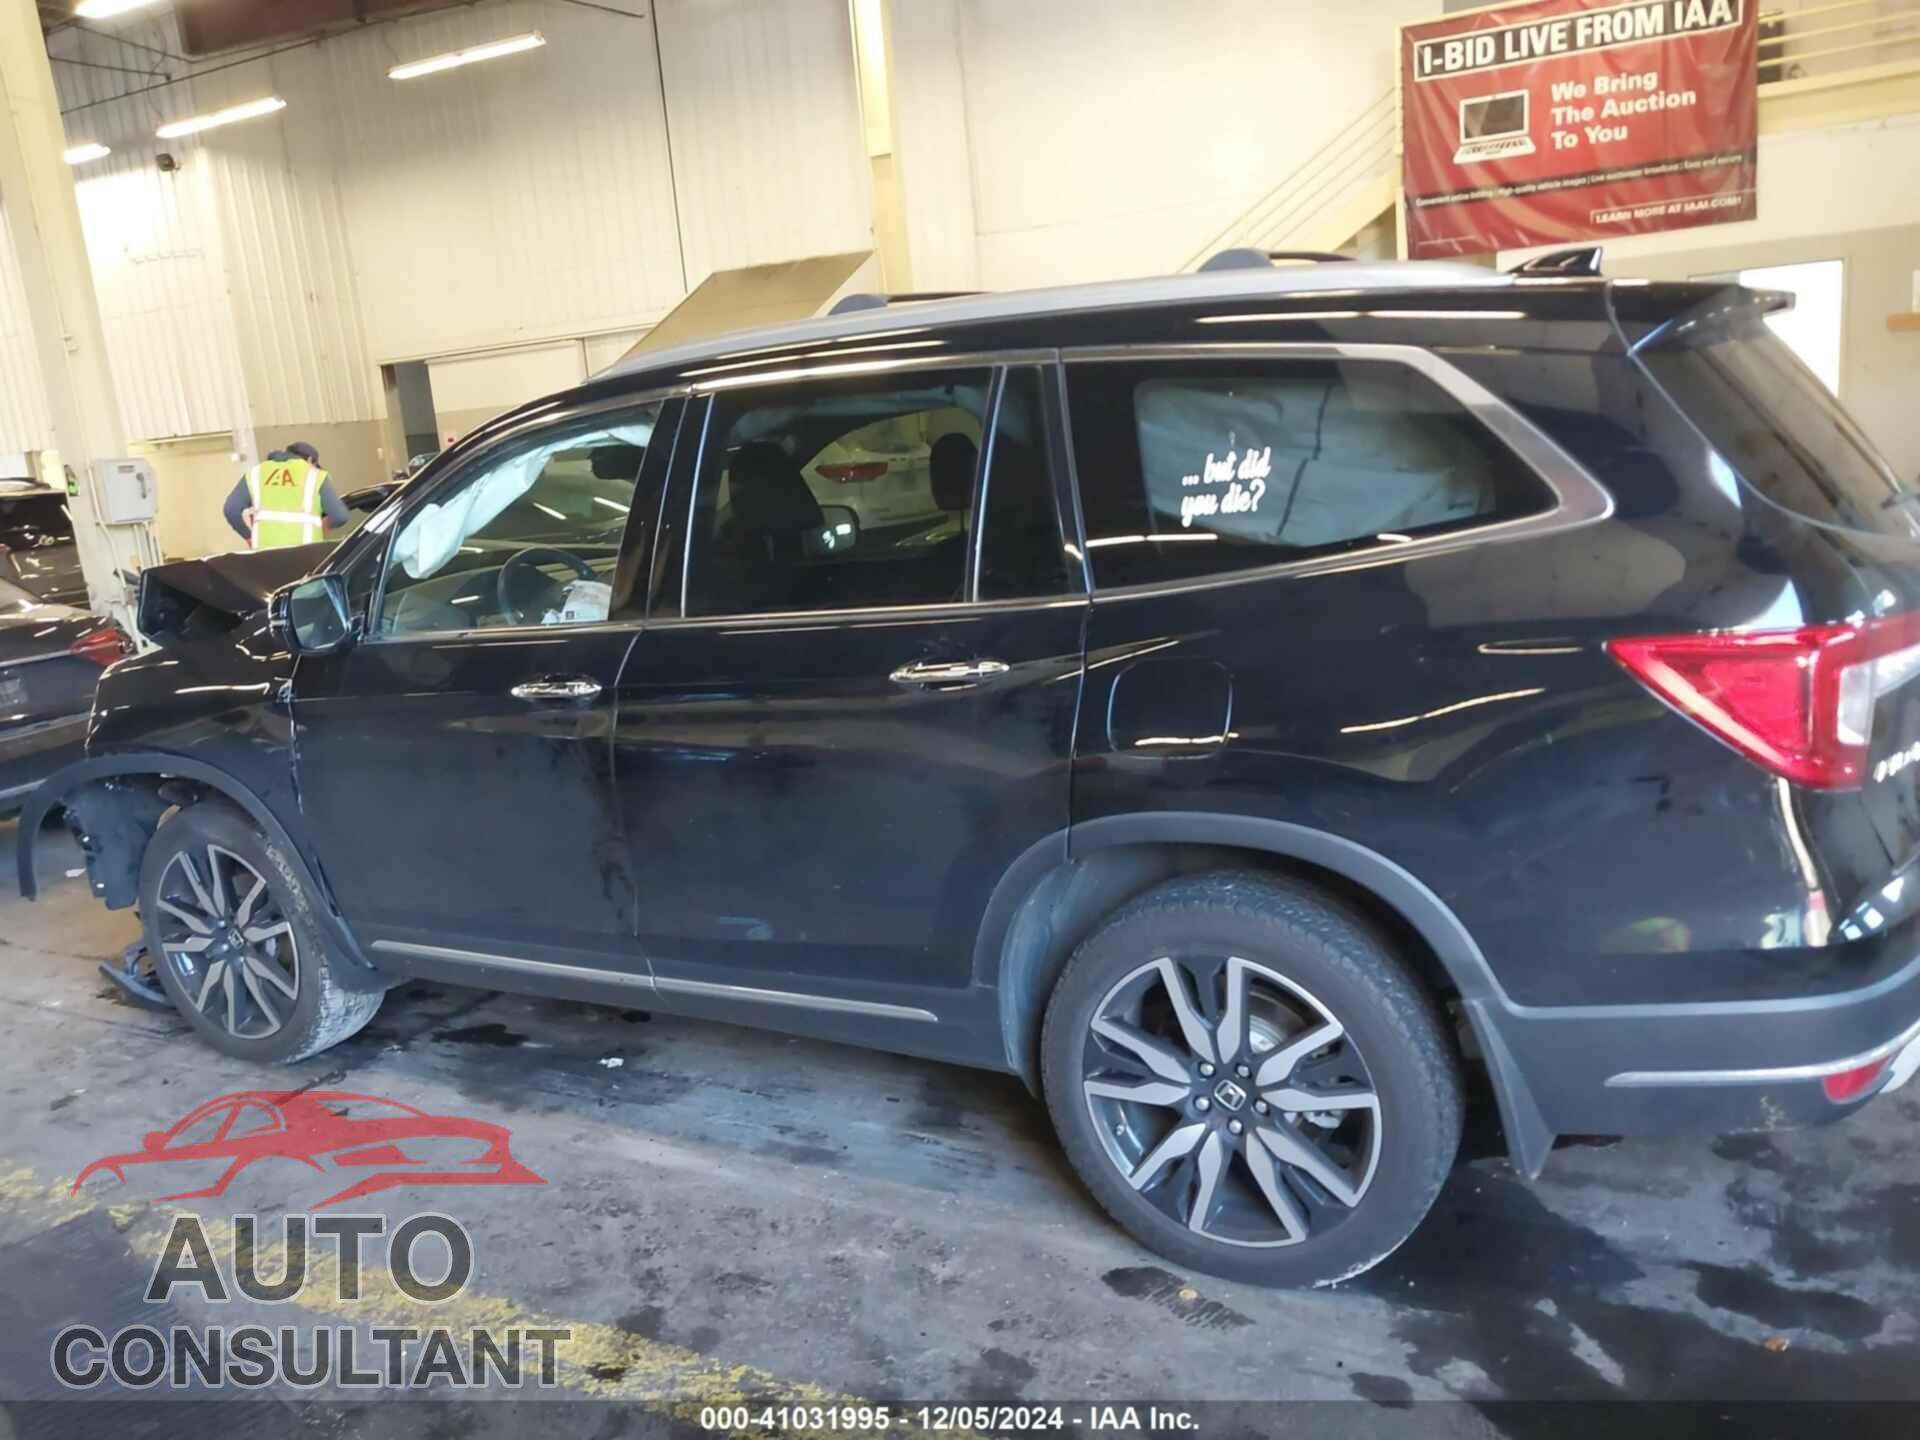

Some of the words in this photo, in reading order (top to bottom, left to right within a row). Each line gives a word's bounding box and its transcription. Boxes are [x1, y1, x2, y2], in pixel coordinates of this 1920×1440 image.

[1423, 35, 1496, 74] I-BID
[1503, 20, 1571, 61] LIVE
[1576, 3, 1665, 48] FROM
[1674, 0, 1733, 31] IAA
[1551, 80, 1587, 102] We
[1594, 71, 1658, 95] Bring
[1551, 106, 1595, 126] The
[1600, 90, 1697, 119] Auction
[1551, 130, 1579, 150] To
[1584, 125, 1628, 145] You
[1203, 451, 1237, 484] but
[1237, 446, 1272, 480] did
[1180, 494, 1219, 528] you
[1220, 478, 1266, 513] die?
